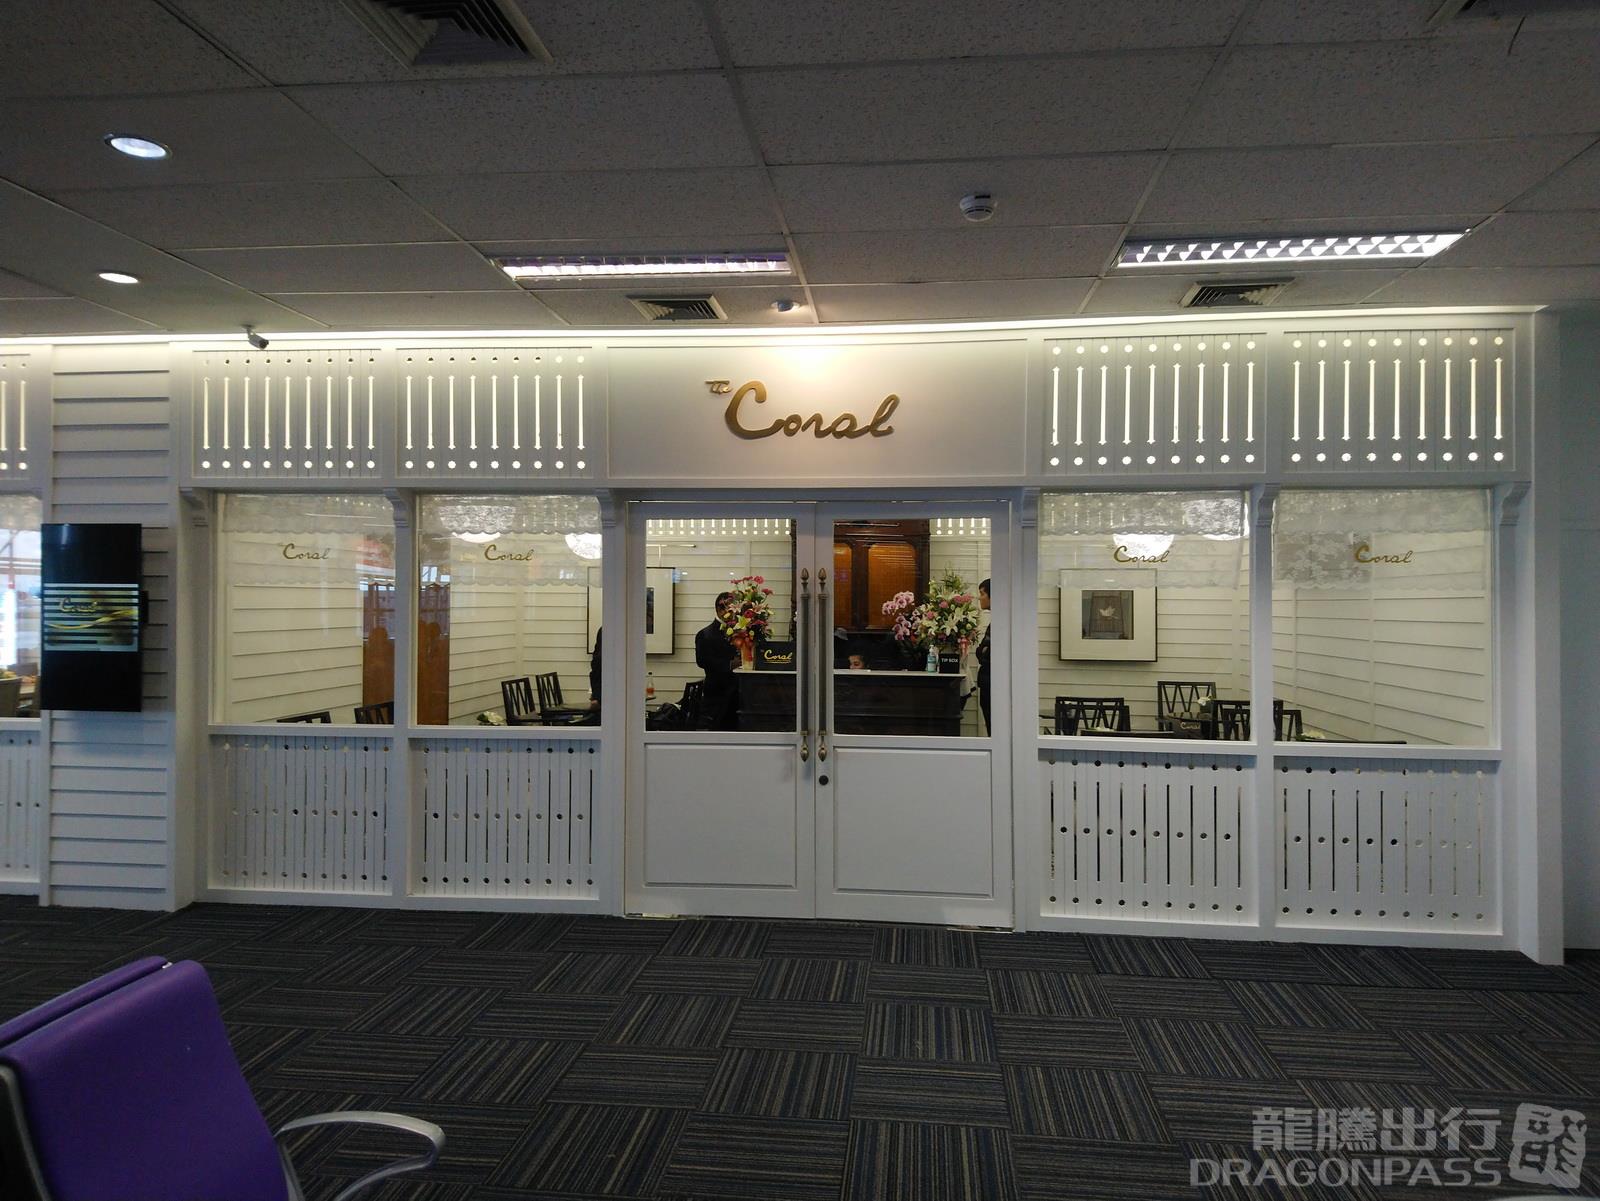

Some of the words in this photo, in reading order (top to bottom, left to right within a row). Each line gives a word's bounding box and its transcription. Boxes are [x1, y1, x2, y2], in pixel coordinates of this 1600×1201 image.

[724, 380, 900, 440] Coral
[282, 542, 331, 560] Coral
[484, 543, 534, 561] Coral
[1113, 545, 1170, 563] Coral
[1354, 544, 1413, 564] Coral
[763, 649, 793, 660] Coral
